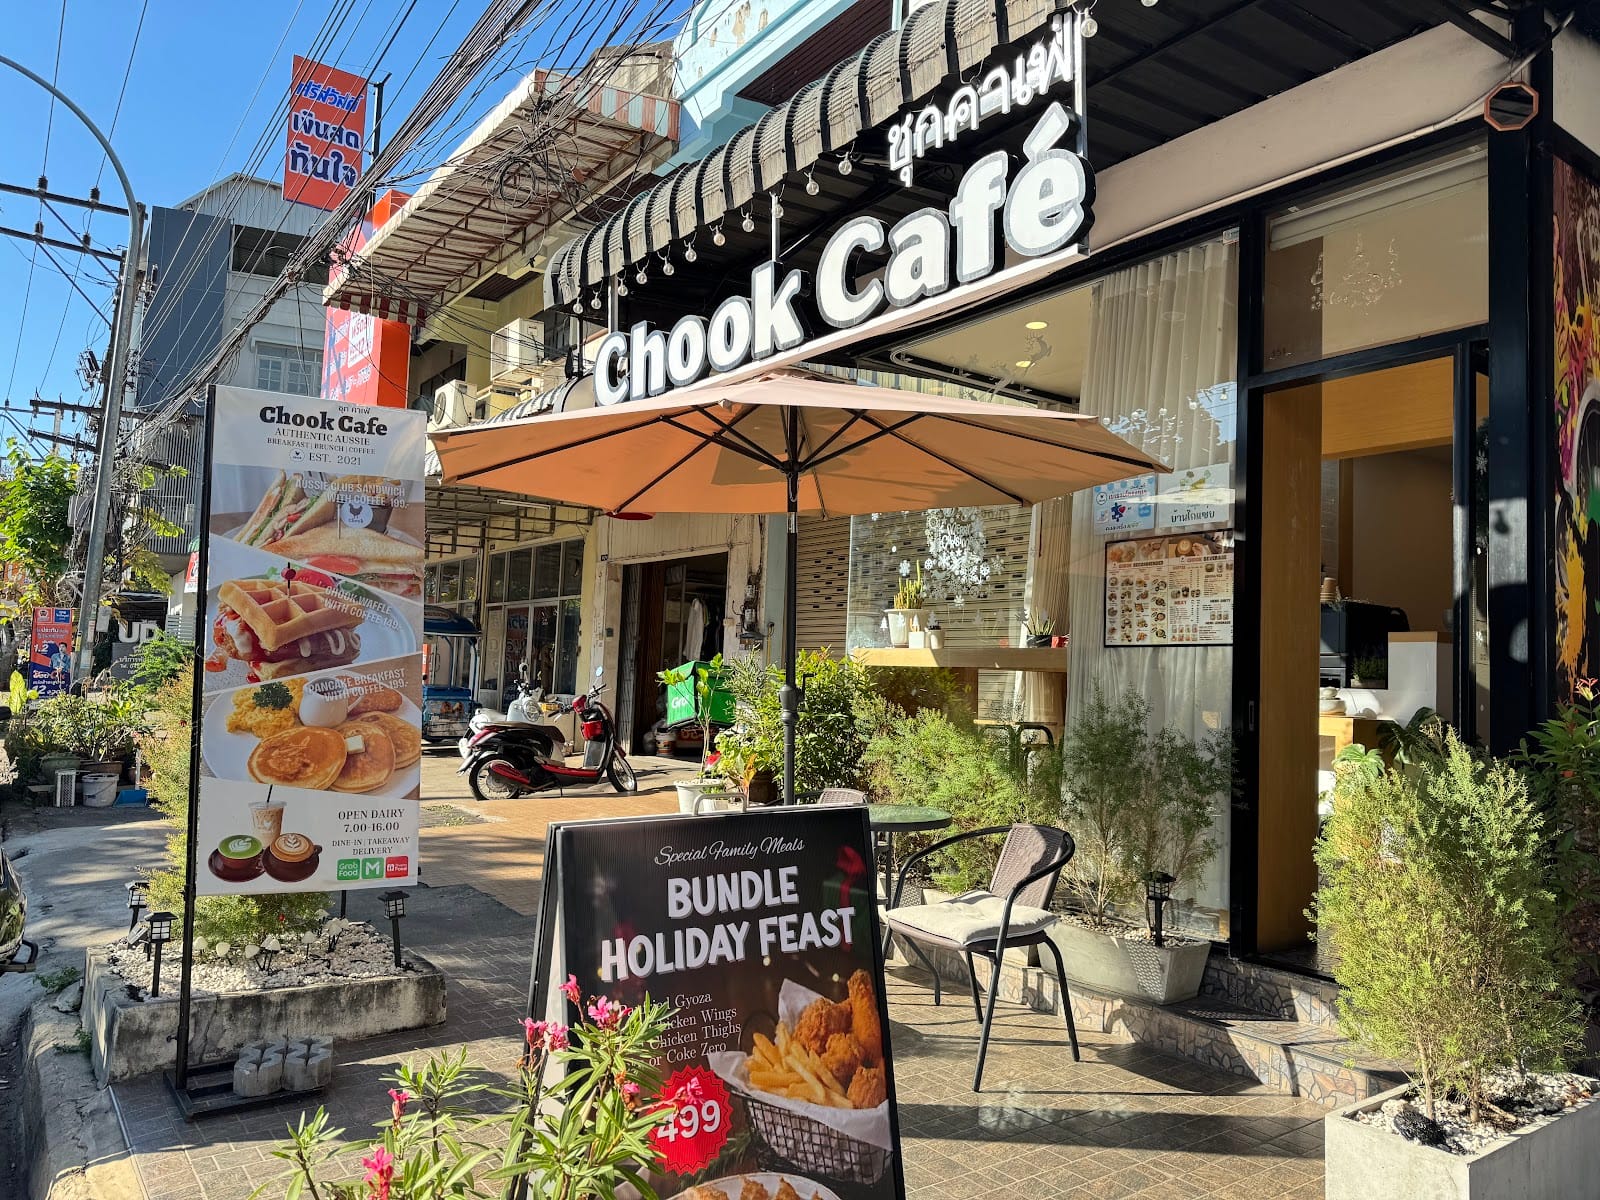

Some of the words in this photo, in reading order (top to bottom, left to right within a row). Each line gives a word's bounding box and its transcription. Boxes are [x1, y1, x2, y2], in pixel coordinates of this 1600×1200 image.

[292, 110, 361, 149] เงินสด
[289, 141, 357, 187] ทันใจ
[592, 260, 805, 407] Chook
[816, 101, 1090, 329] Café
[260, 405, 335, 430] Chook
[338, 415, 388, 436] Cafe
[275, 427, 333, 442] AUTHENTIC
[334, 435, 370, 446] AUSSIE
[267, 437, 310, 449] BREAKFAST
[314, 443, 344, 452] BRUNCH
[348, 446, 376, 455] COFFEE
[309, 452, 332, 463] EST.
[337, 455, 361, 466] 2021
[295, 479, 329, 491] AUSSIE
[331, 482, 354, 493] CLUB
[357, 483, 405, 497] SANDWICH
[327, 493, 351, 503] WITH
[353, 494, 386, 506] COFFEE
[325, 586, 358, 603] CHOOK
[358, 597, 393, 615] WAFFLE
[324, 598, 350, 614] WITH
[350, 606, 382, 625] COFFEE
[308, 678, 353, 693] PANCAKE
[354, 668, 405, 685] BREAKFAST
[324, 689, 350, 702] WITH
[352, 684, 384, 697] COFFEE
[338, 810, 368, 820] OPEN
[371, 808, 405, 819] DAIRY
[332, 839, 362, 847] DINE-IN
[367, 836, 410, 846] TAKEAWAY
[352, 846, 393, 856] DELIVERY
[654, 845, 708, 867] Special
[709, 840, 759, 860] Family
[760, 836, 805, 855] Meals
[339, 861, 358, 870] Grab
[339, 868, 358, 877] Food
[667, 865, 800, 920] BUNDLE
[600, 920, 752, 983] HOLIDAY
[758, 906, 856, 957] FEAST
[675, 993, 712, 1010] Gyoza
[701, 1007, 737, 1024] Wings
[702, 1022, 742, 1040] Thighs
[649, 1056, 662, 1067] or
[666, 1049, 697, 1064] Coke
[701, 1042, 727, 1056] Zero
[656, 1099, 721, 1143] 499
